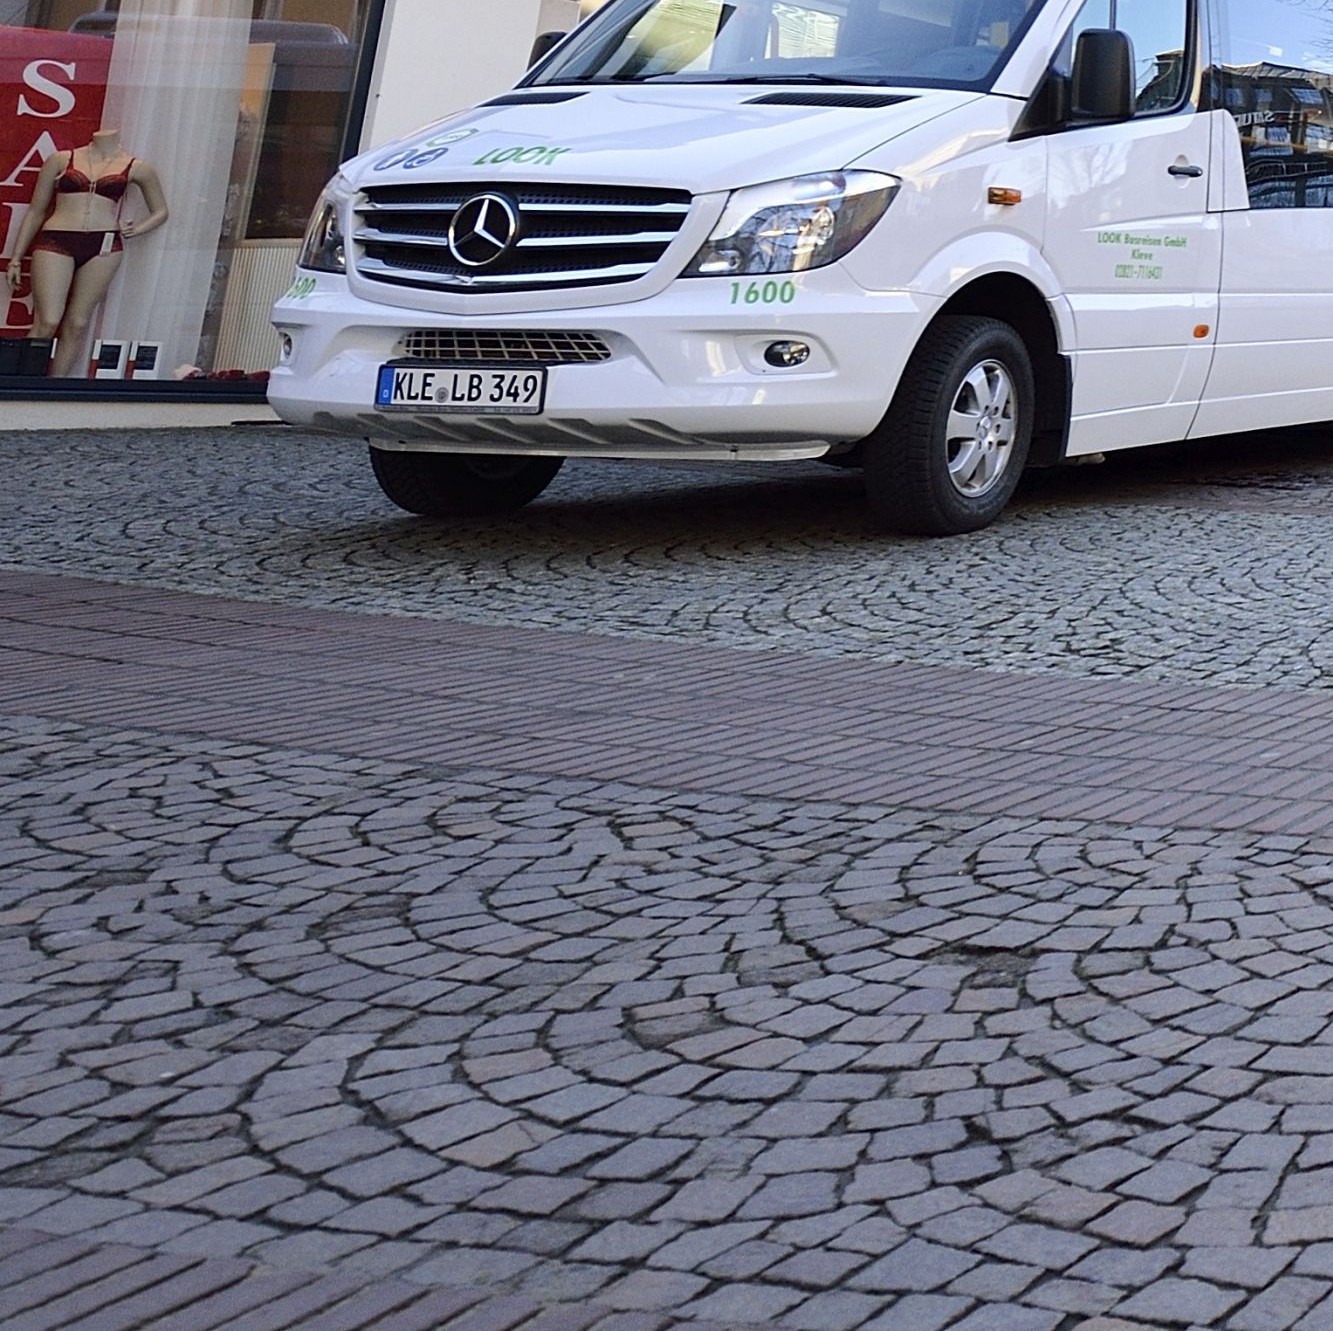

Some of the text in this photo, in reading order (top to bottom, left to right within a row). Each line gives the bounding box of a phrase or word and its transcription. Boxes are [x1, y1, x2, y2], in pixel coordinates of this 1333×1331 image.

[473, 146, 571, 166] LOOK
[1097, 232, 1121, 243] LOOK
[730, 281, 795, 304] 1600
[393, 372, 538, 403] KLE LB 349
